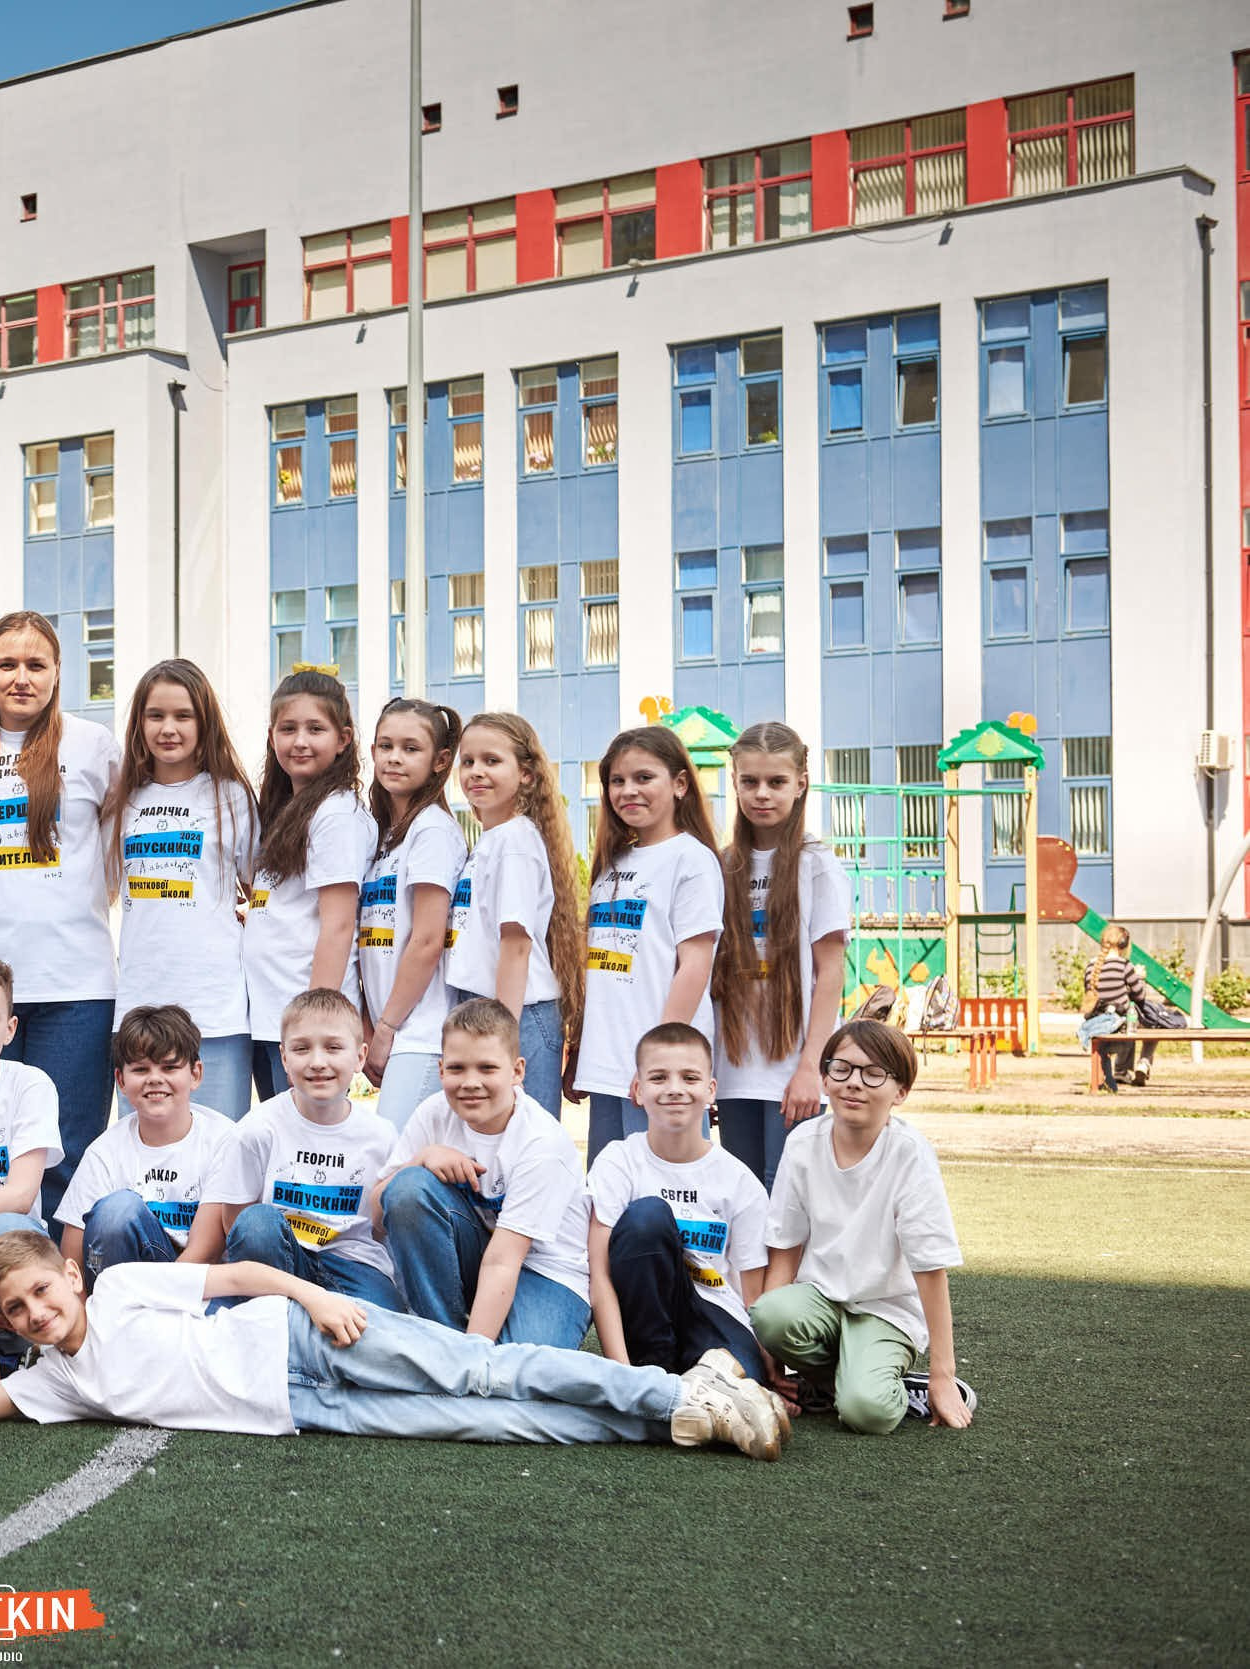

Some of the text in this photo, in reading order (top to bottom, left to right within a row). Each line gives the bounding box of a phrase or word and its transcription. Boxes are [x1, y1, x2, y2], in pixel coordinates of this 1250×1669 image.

[139, 806, 190, 818] МАРІЧКА
[180, 832, 201, 841] 2024
[125, 842, 200, 856] ВИПУСКНИЦЯ
[160, 890, 190, 899] ШКОЛИ
[599, 961, 628, 972] ШКОЛИ
[296, 1151, 345, 1169] ГЕОРГІЙ
[273, 1187, 358, 1213] ВИПУСКНИК
